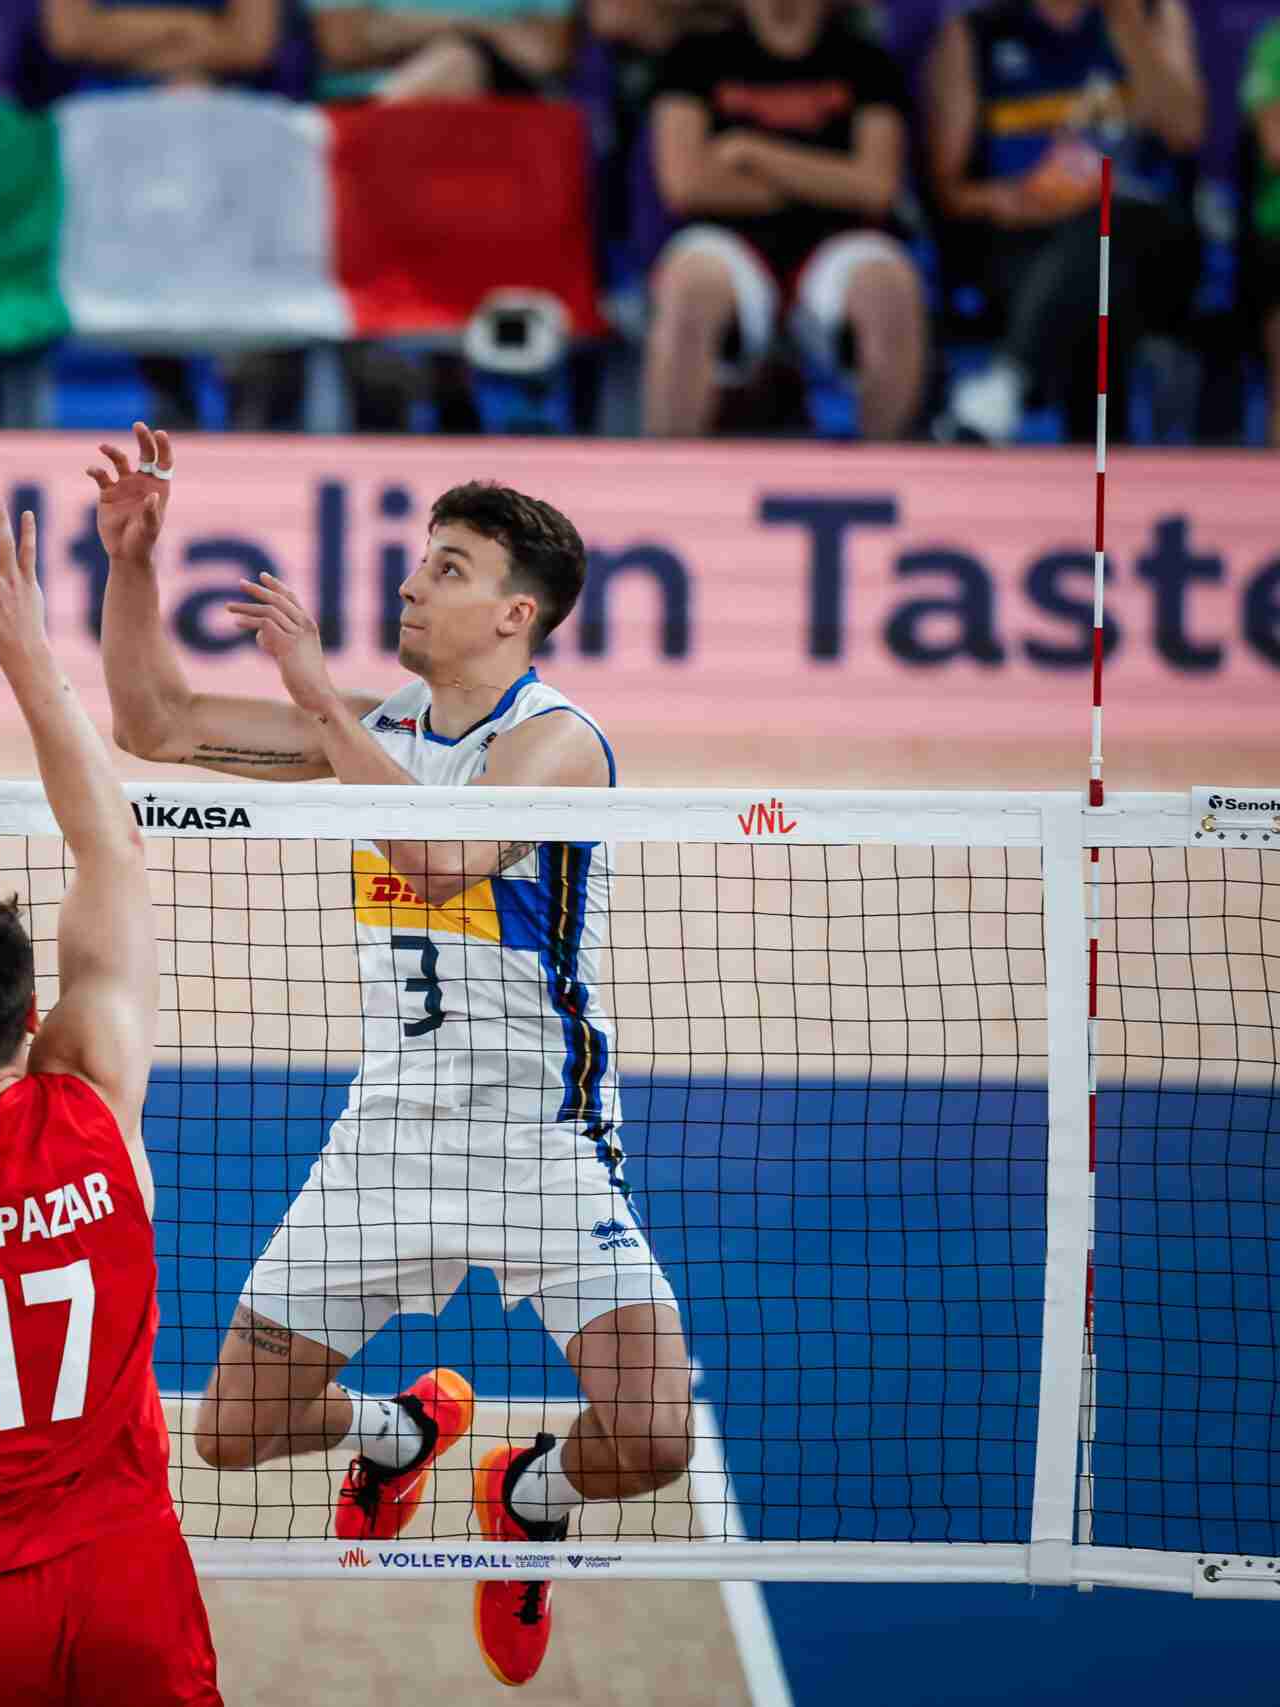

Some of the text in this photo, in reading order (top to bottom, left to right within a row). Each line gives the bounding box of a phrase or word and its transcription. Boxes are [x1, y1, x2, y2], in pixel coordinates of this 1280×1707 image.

[9, 480, 688, 661] alin
[131, 793, 251, 829] IKASA
[737, 797, 797, 836] VNL
[1225, 798, 1280, 810] Senoh
[368, 876, 426, 904] DH
[391, 935, 446, 1037] 3
[338, 1547, 512, 1568] VNL VOLLEYBALL
